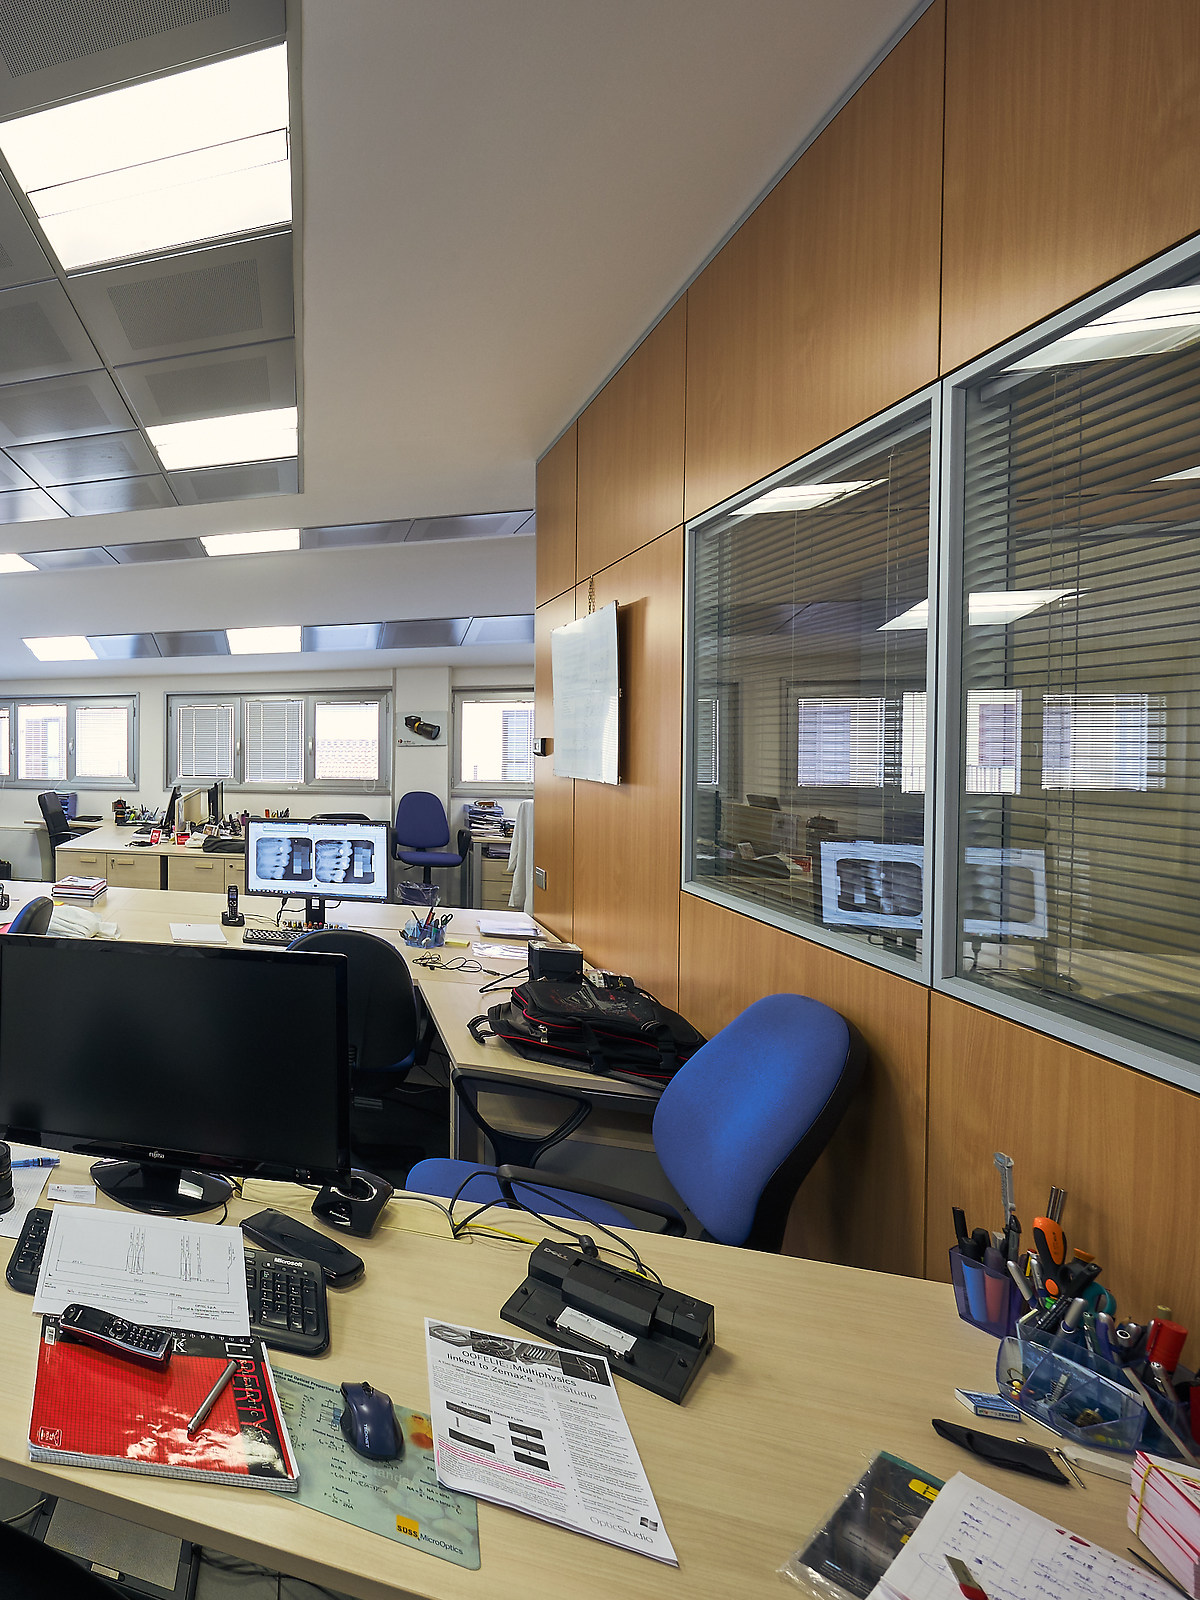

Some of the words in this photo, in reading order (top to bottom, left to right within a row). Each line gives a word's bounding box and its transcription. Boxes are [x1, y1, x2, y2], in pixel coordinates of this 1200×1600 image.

[274, 1257, 303, 1268] Microsoft
[447, 1352, 476, 1368] linked
[478, 1359, 489, 1371] to
[491, 1363, 534, 1383] Zemax's
[535, 1376, 598, 1400] OpticStudio
[590, 1516, 654, 1544] OpticStudio
[419, 1533, 464, 1555] MicroOptics
